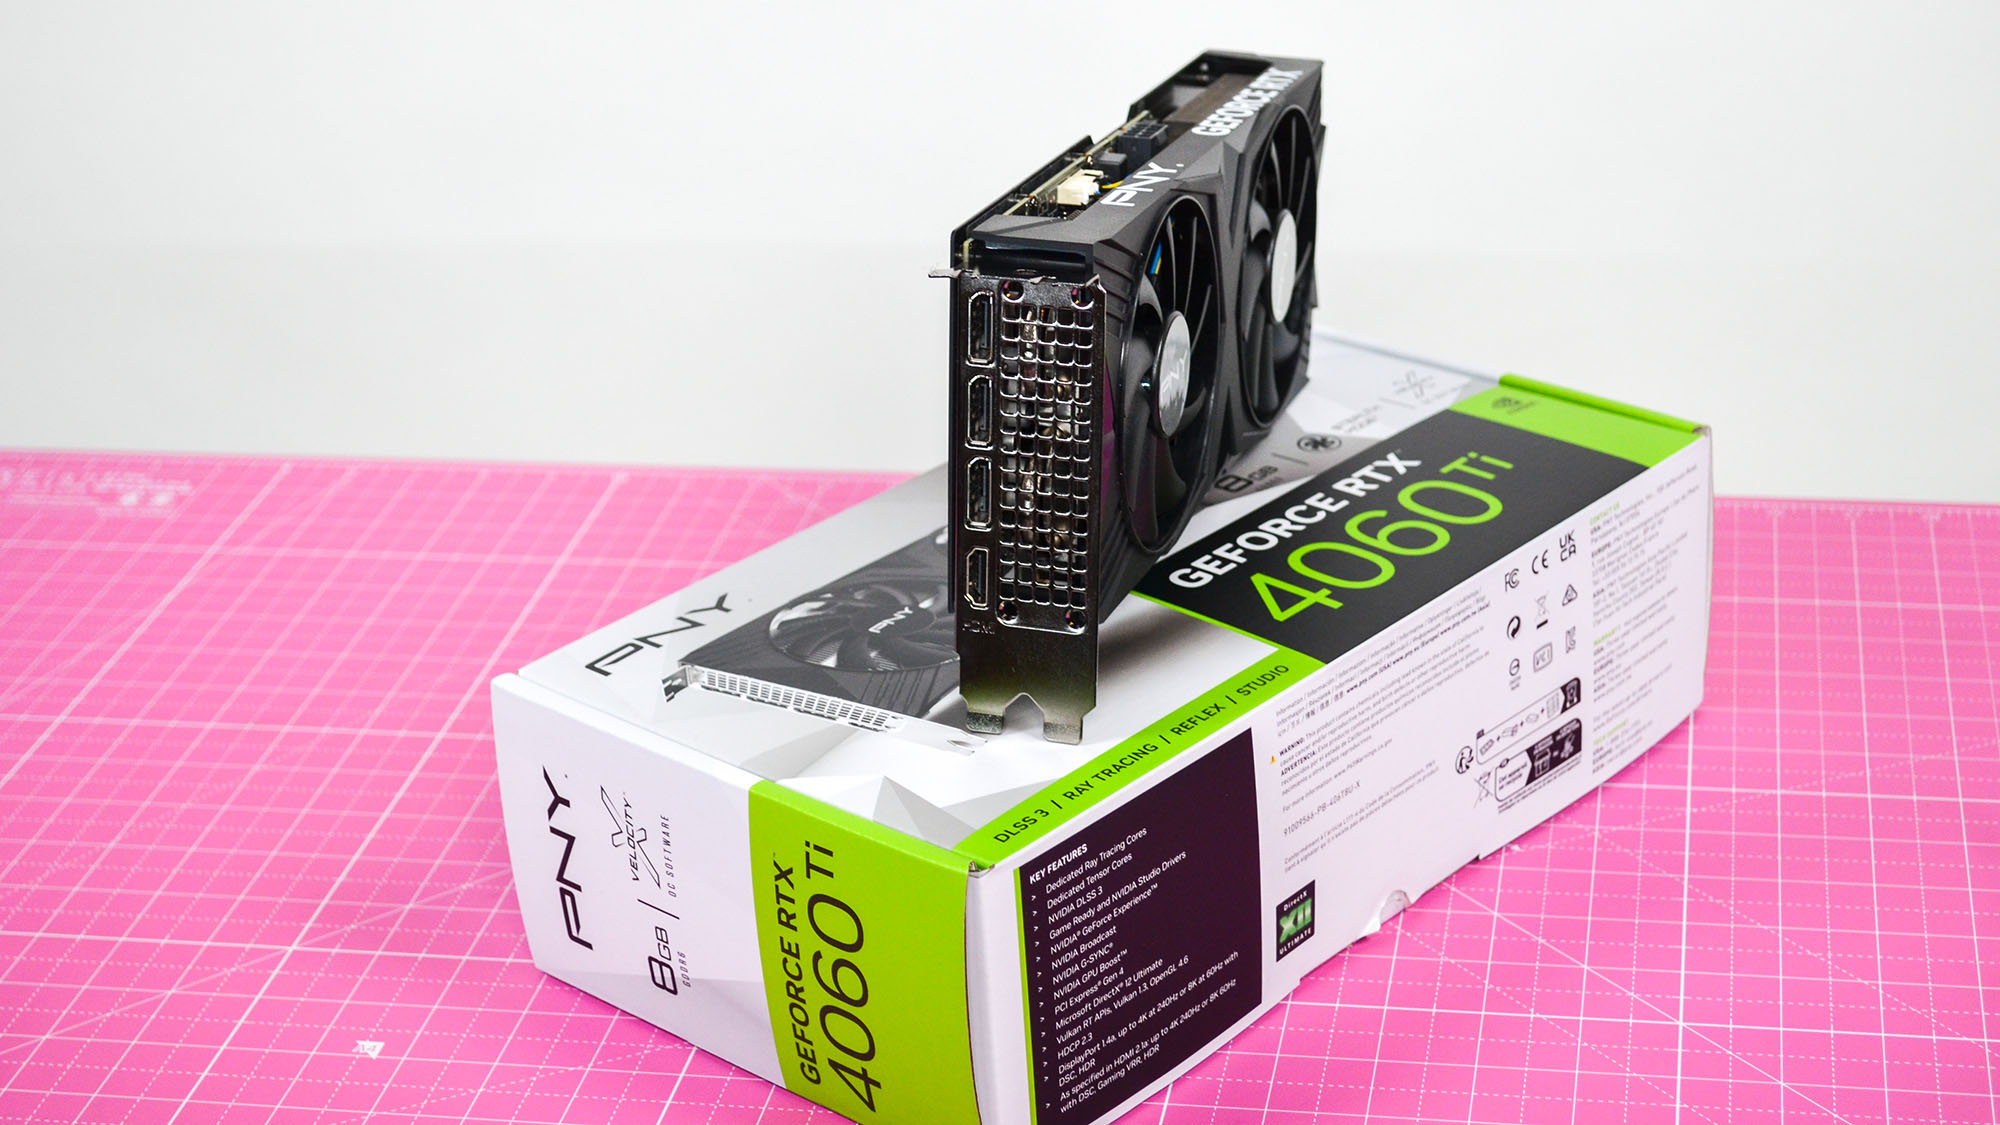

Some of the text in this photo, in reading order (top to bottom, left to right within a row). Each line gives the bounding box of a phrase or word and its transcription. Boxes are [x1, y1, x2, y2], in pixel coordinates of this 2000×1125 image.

[1191, 66, 1304, 137] GEFORCE RTX
[1168, 491, 1350, 589] GEFORCE
[1250, 479, 1504, 622] 4060
[1440, 451, 1515, 481] Ti
[585, 593, 733, 676] PNY
[868, 606, 914, 634] PNY
[993, 815, 1038, 844] DLSS
[1033, 807, 1050, 820] 3
[1062, 778, 1096, 802] RAY
[1091, 742, 1159, 786] TRACING
[1170, 702, 1226, 736] REFLEX
[1236, 664, 1290, 697] STUDIO
[622, 795, 641, 883] VELOCITY
[660, 814, 677, 898] OC SOFTWARE
[1029, 843, 1088, 885] KEY FEATURES
[1045, 827, 1147, 894] Dedicated Ray Tracing Cores
[1046, 852, 1133, 909] Dedicated Tensor Cores
[1048, 885, 1103, 925] NVIDIA DLSS 3
[1049, 851, 1186, 940] Game Ready and NVIDIA Studio Drivers
[1051, 925, 1117, 970] NVIDIA Broadcast
[1081, 913, 1112, 936] GeForce
[1279, 927, 1312, 955] ULTIMATE
[648, 926, 679, 996] 8GB
[804, 840, 883, 1114] 4060 Ti
[1052, 963, 1080, 985] NVIDIA
[1053, 978, 1081, 1000] NVIDIA
[1081, 966, 1099, 983] GPU
[1054, 1000, 1068, 1015] PCI
[1102, 971, 1118, 986] Gen
[1118, 966, 1124, 975] 4
[1055, 1002, 1092, 1030] Microsoft
[1124, 976, 1132, 987] 12
[1132, 958, 1163, 982] Ultimate
[779, 936, 822, 1086] GEFORCE
[1055, 1024, 1082, 1044] Vulkan
[1082, 1015, 1093, 1029] RT
[1112, 990, 1138, 1009] Vulkan
[1149, 963, 1177, 987] OpenGL
[1177, 954, 1189, 967] 4.6
[1058, 1042, 1101, 1075] DisplayPort
[1117, 1026, 1128, 1038] up
[1128, 1020, 1137, 1031] to
[1137, 1011, 1148, 1024] 4K
[1148, 1007, 1156, 1018] at
[1156, 992, 1179, 1012] 240Hz
[1178, 986, 1187, 997] or
[1187, 978, 1198, 991] 8K
[1197, 973, 1206, 984] at
[1205, 961, 1224, 978] 60Hz
[1223, 951, 1239, 966] with
[1057, 1031, 1093, 1060] HDCP 2.3
[1059, 1090, 1071, 1102] As
[1071, 1066, 1105, 1095] specified
[1105, 1063, 1113, 1073] in
[1113, 1047, 1134, 1068] HDMI
[1150, 1032, 1160, 1044] up
[1160, 1026, 1169, 1036] to
[1169, 1017, 1179, 1030] 4K
[1179, 1003, 1201, 1024] 240Hz
[1200, 998, 1209, 1008] or
[1209, 989, 1219, 1002] 8K
[1218, 978, 1236, 995] 60Hz
[1078, 1057, 1096, 1075] HDR
[1060, 1098, 1078, 1113] with
[1097, 1067, 1125, 1090] Gaming
[1143, 1043, 1160, 1060] HDR
